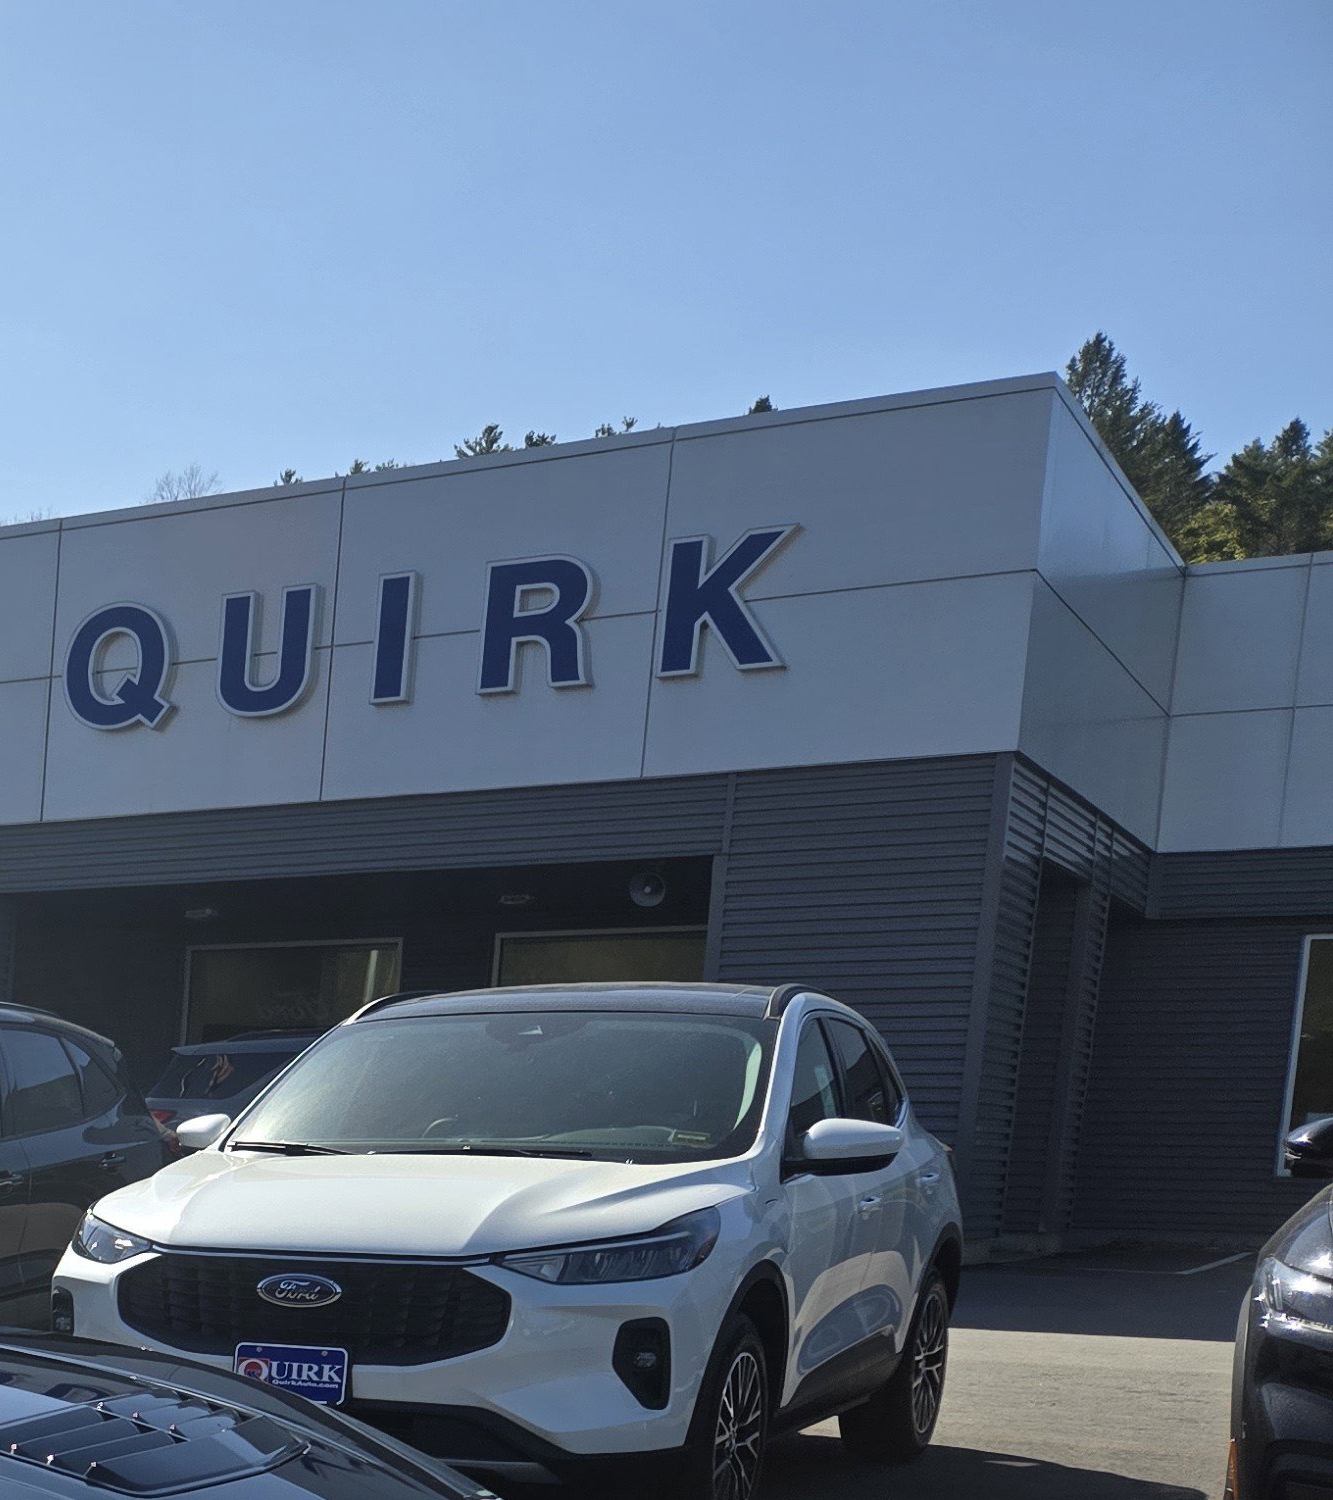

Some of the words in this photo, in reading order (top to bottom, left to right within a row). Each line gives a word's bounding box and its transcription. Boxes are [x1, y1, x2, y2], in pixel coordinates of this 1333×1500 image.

[64, 523, 800, 731] QUIRK
[274, 1279, 321, 1300] Ford
[238, 1359, 342, 1382] QUIRK
[272, 1379, 339, 1389] QuirkAuto.com
